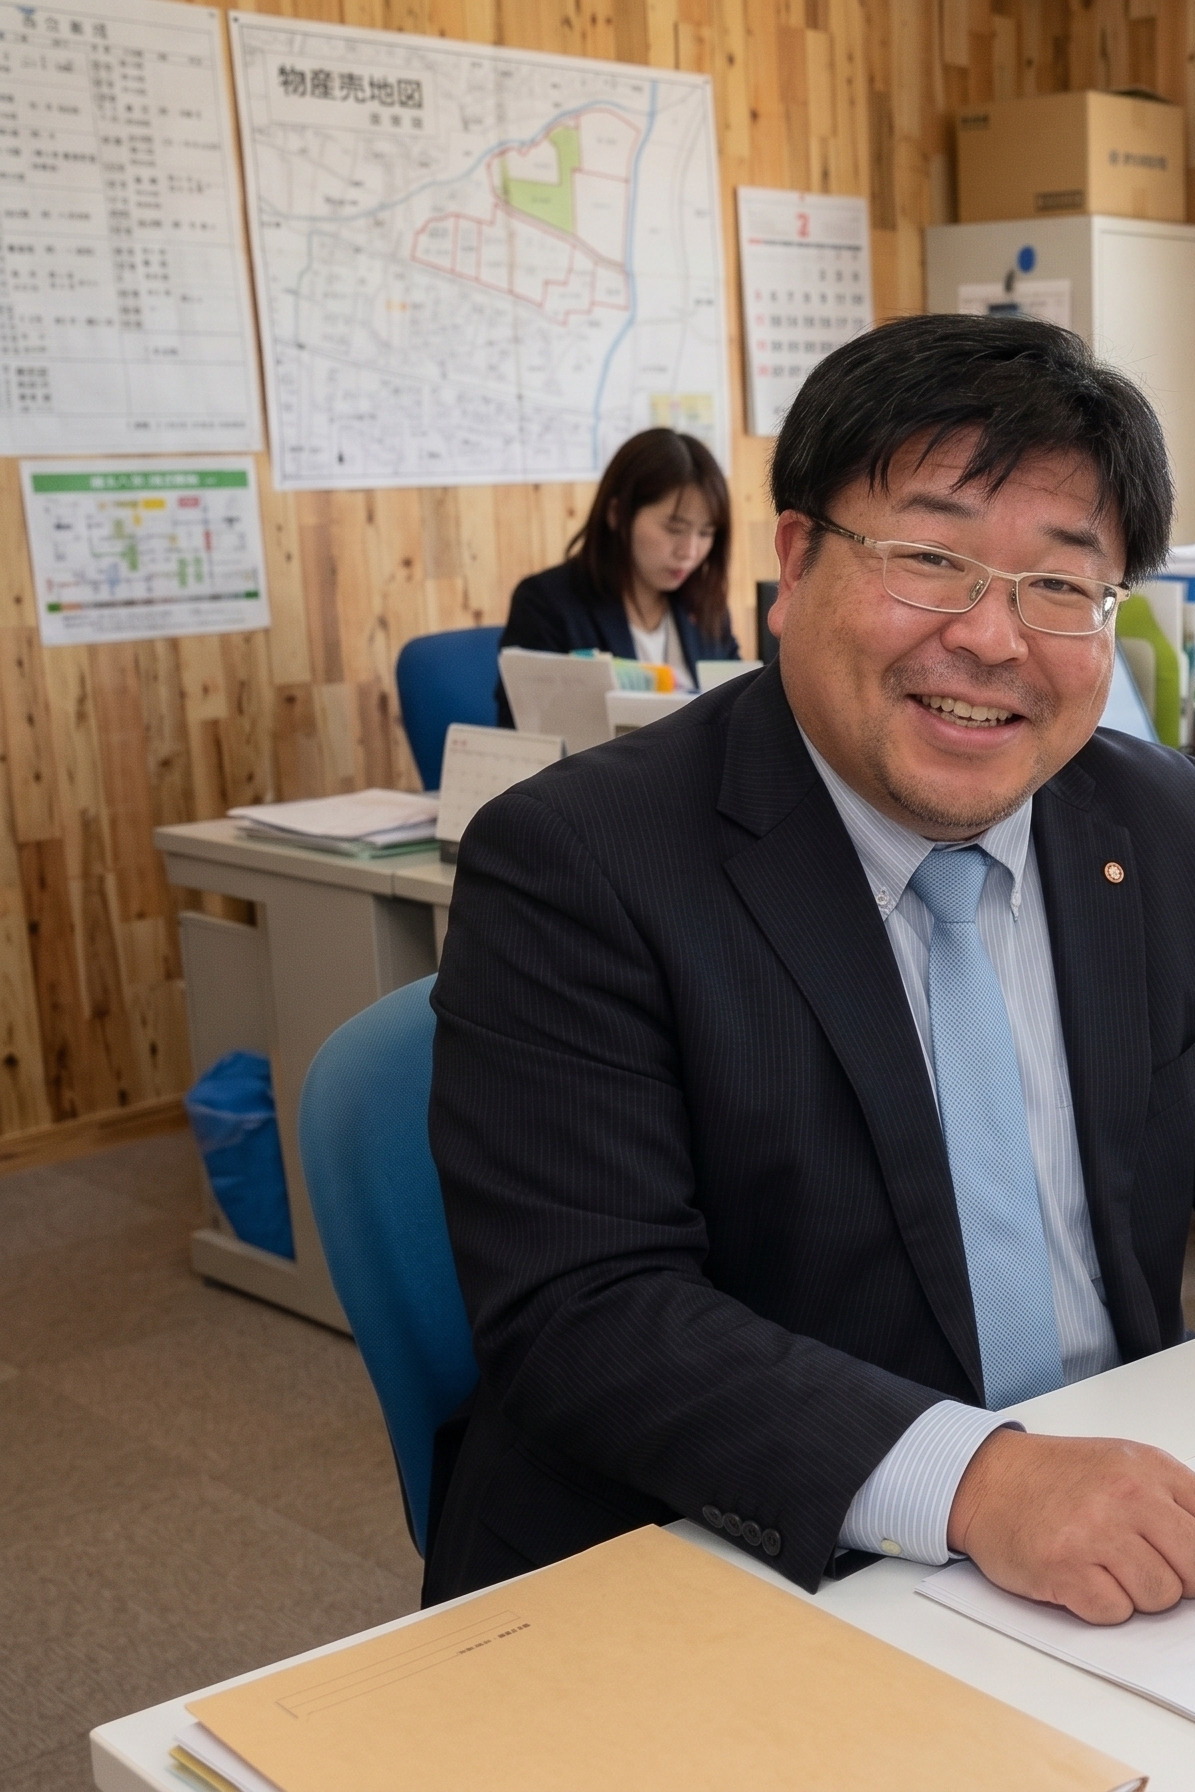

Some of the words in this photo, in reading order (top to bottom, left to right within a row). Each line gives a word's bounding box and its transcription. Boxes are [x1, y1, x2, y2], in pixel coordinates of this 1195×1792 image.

[278, 65, 422, 109] 物産売地図
[797, 212, 811, 238] 2
